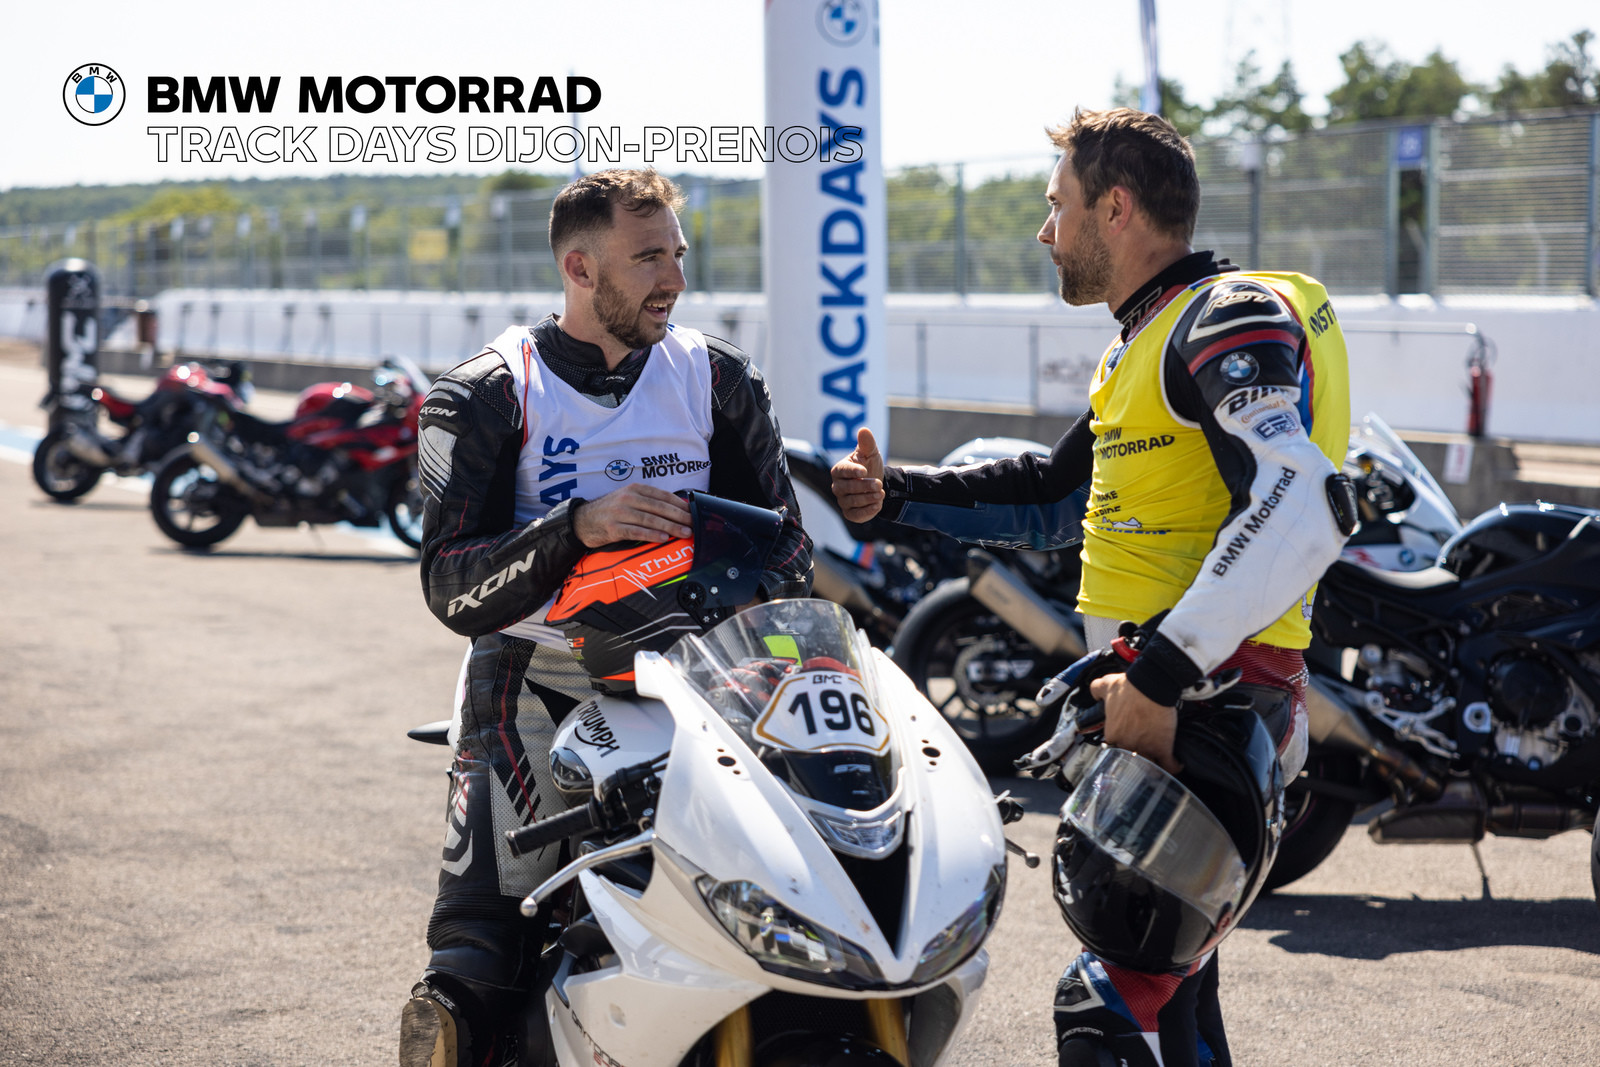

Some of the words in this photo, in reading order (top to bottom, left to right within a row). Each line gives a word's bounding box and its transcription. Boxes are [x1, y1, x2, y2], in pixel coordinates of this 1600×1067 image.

[641, 452, 681, 467] BMW
[1211, 532, 1251, 577] BMW
[1243, 466, 1297, 534] Motorrad
[812, 674, 842, 684] BMC
[577, 700, 620, 758] TRIUMPH
[788, 689, 876, 736] 196
